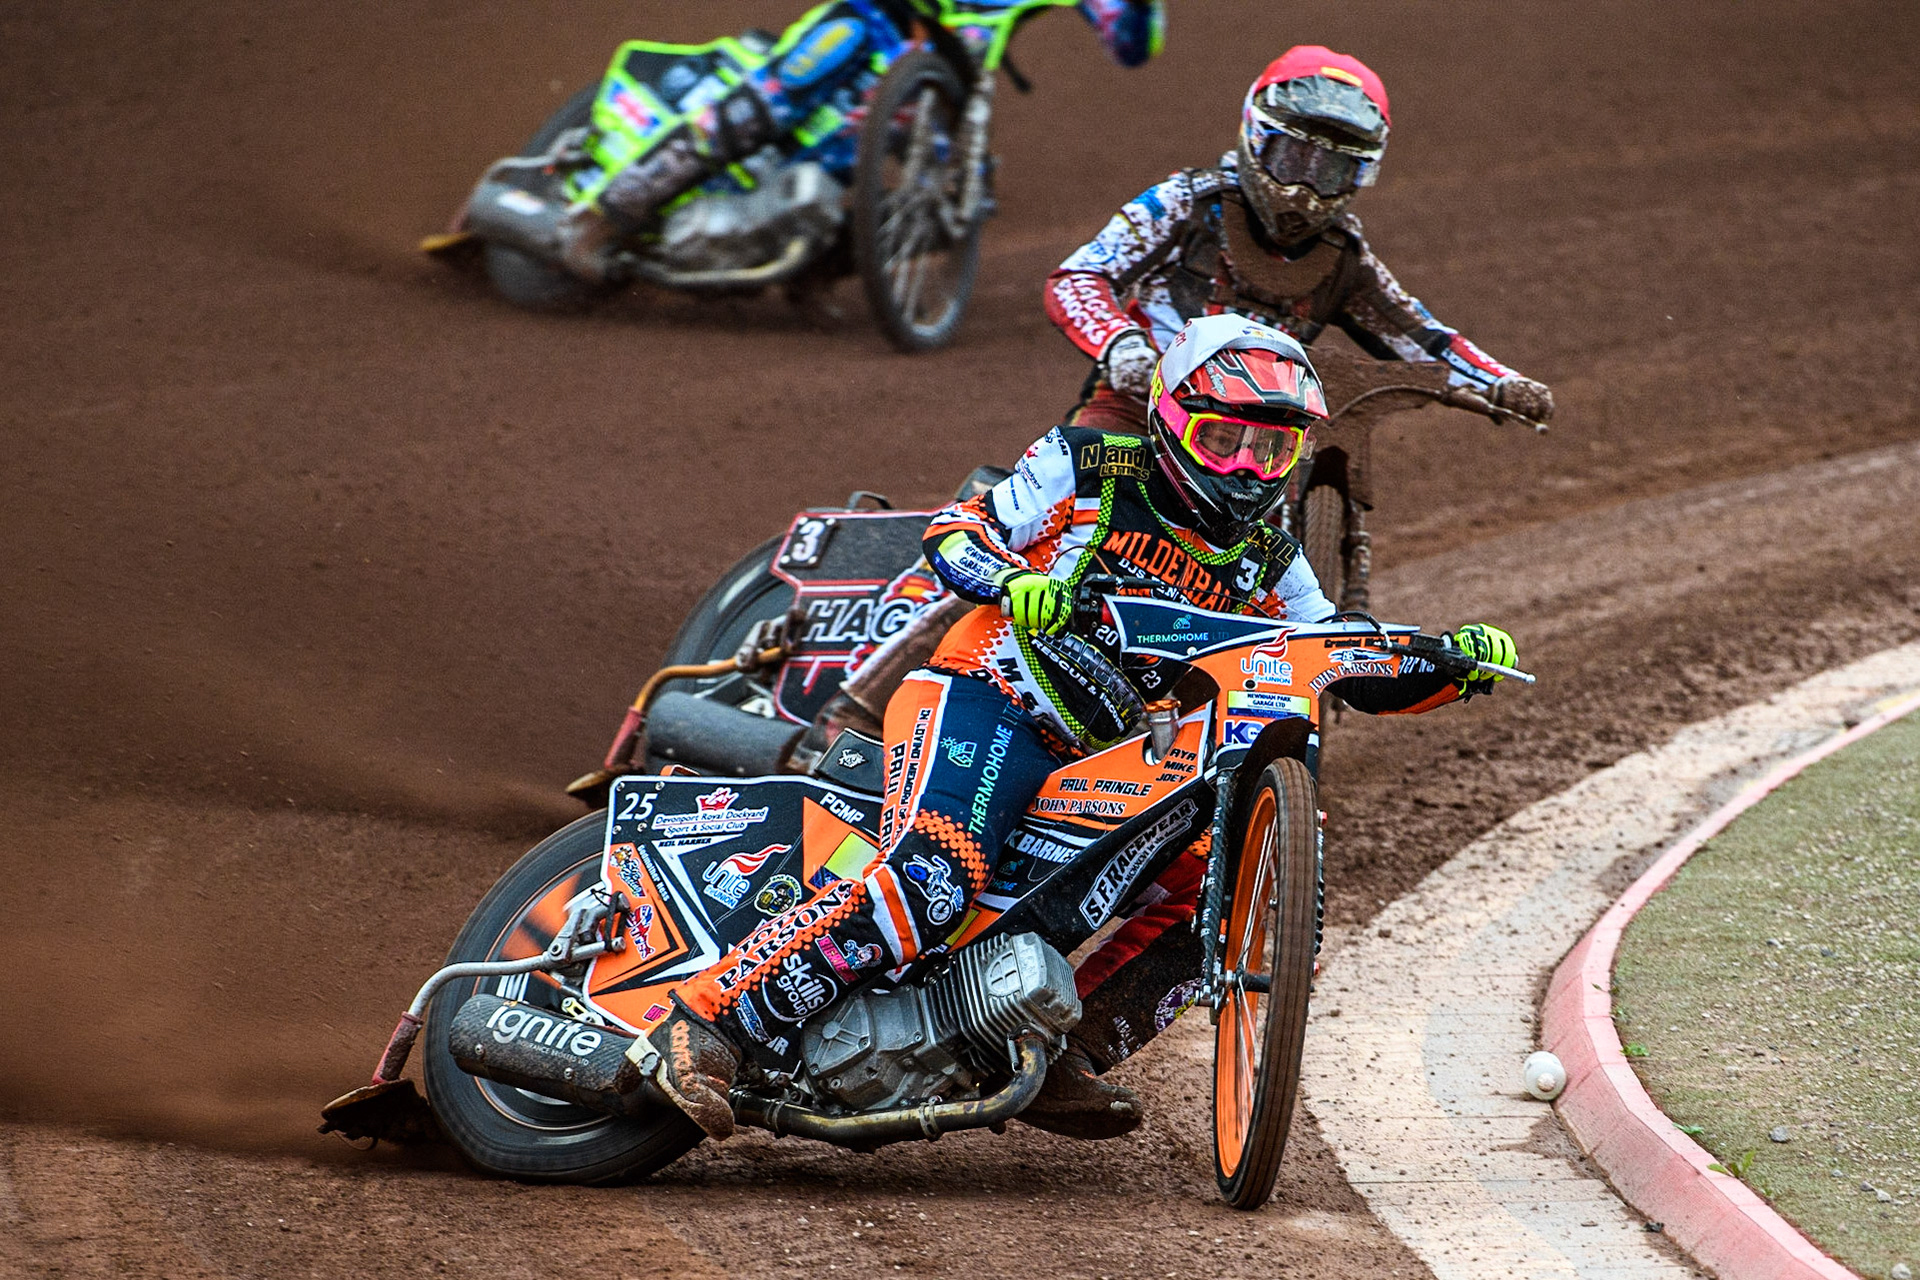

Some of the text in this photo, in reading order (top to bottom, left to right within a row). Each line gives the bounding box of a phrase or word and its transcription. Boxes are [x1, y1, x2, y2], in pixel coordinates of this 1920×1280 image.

[1080, 444, 1099, 470] N
[1105, 447, 1147, 469] and
[1099, 463, 1151, 483] LETTINGS
[790, 520, 825, 562] 3
[1235, 557, 1260, 592] 3
[1094, 624, 1119, 647] 20
[1136, 632, 1209, 644] THERMOHOME
[1030, 638, 1092, 688] RESCUE
[1087, 684, 1098, 696] &
[1140, 669, 1162, 690] 23
[1241, 659, 1292, 676] unite
[1308, 667, 1338, 696] JOHN
[1338, 661, 1394, 678] PARSONS
[1277, 694, 1292, 702] PARK
[969, 724, 1014, 836] THERMOHOME
[1155, 773, 1188, 784] JOEY
[1163, 761, 1196, 774] MIKE
[1058, 778, 1152, 797] PAUL PRINGLE
[616, 792, 658, 821] 25
[655, 809, 766, 825] Devonport Royal Dockyard
[819, 791, 865, 824] PCMP
[1031, 797, 1126, 816] JOHN PARSONS
[666, 820, 746, 836] Sport & Social Club
[703, 861, 750, 898] unite
[714, 880, 855, 992] PARSONS
[782, 953, 826, 1010] skills
[776, 974, 808, 1017] group
[485, 1004, 602, 1056] ignite
